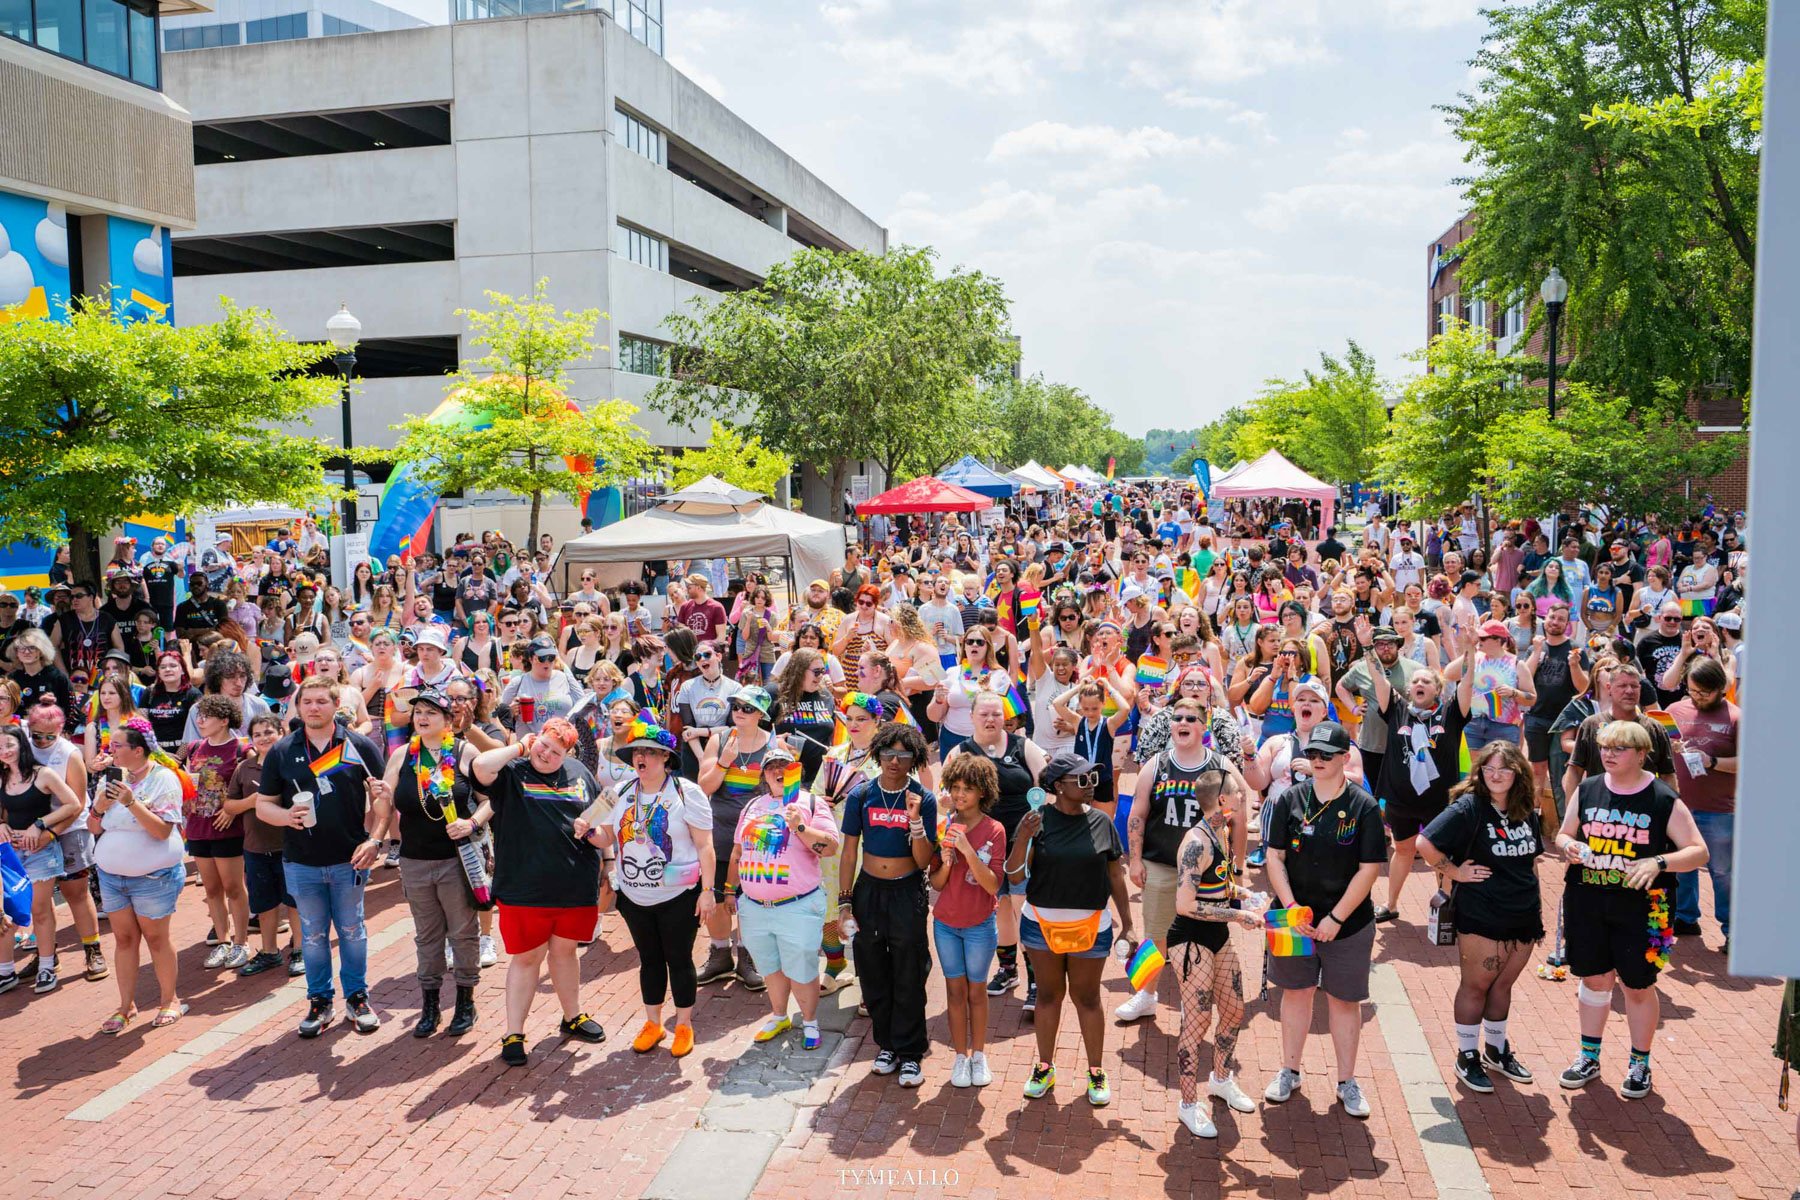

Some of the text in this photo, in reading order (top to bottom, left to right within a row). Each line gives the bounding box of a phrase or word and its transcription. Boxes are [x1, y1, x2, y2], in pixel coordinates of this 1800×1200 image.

[1138, 664, 1165, 680] PRIDE
[797, 701, 813, 712] ARE
[814, 700, 828, 711] ALL
[783, 711, 833, 725] HUMAN
[1155, 779, 1197, 800] PROU
[1164, 797, 1200, 828] AF
[1584, 807, 1650, 829] TRANS
[1487, 821, 1532, 841] i hot
[1582, 821, 1650, 845] PEOPLE
[1491, 839, 1537, 857] dads
[1588, 836, 1637, 858] WILL
[739, 860, 790, 885] MINE
